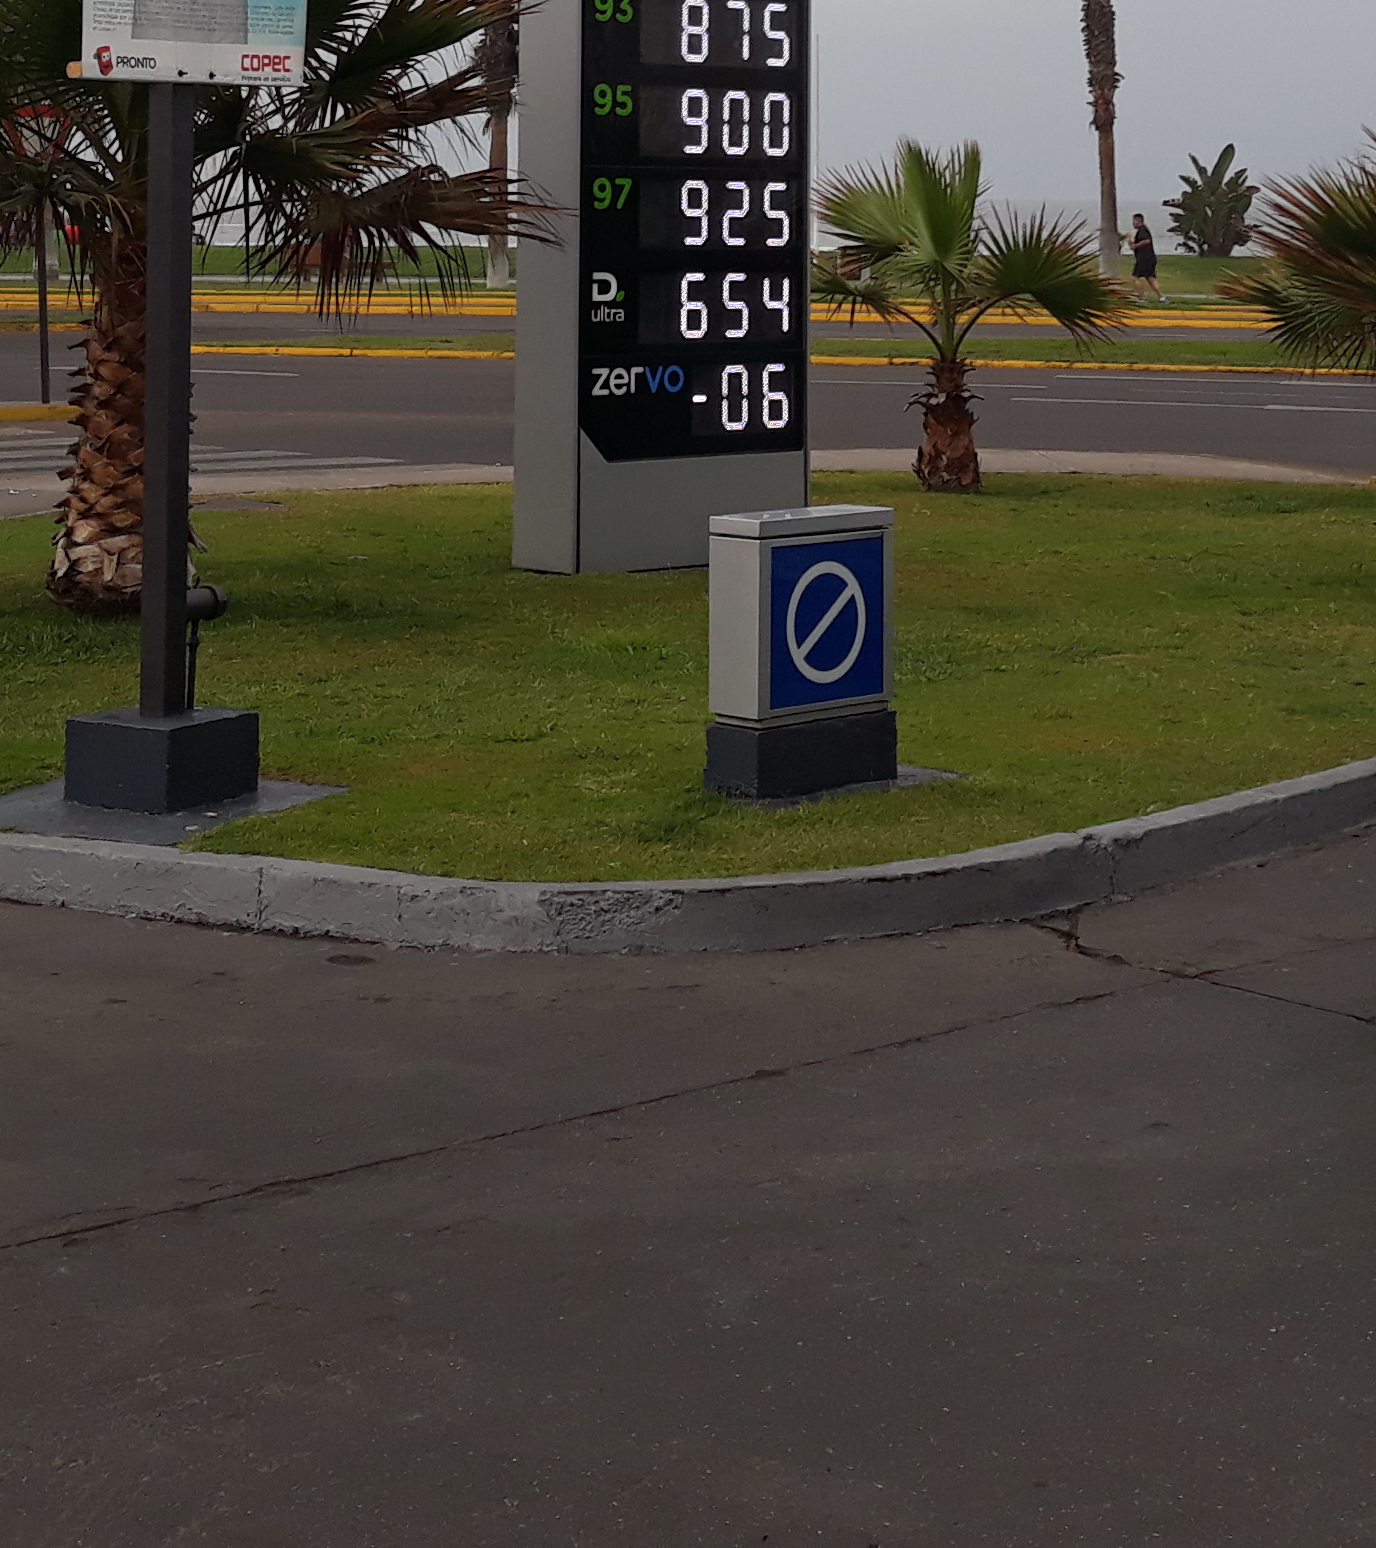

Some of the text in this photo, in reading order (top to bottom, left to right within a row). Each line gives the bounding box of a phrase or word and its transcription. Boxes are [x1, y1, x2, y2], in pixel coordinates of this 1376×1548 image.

[116, 55, 157, 70] PRONTO
[592, 83, 790, 157] 95 900
[592, 177, 790, 247] 97 925
[592, 304, 624, 323] ultra
[680, 272, 790, 339] 654
[592, 365, 684, 396] zervo
